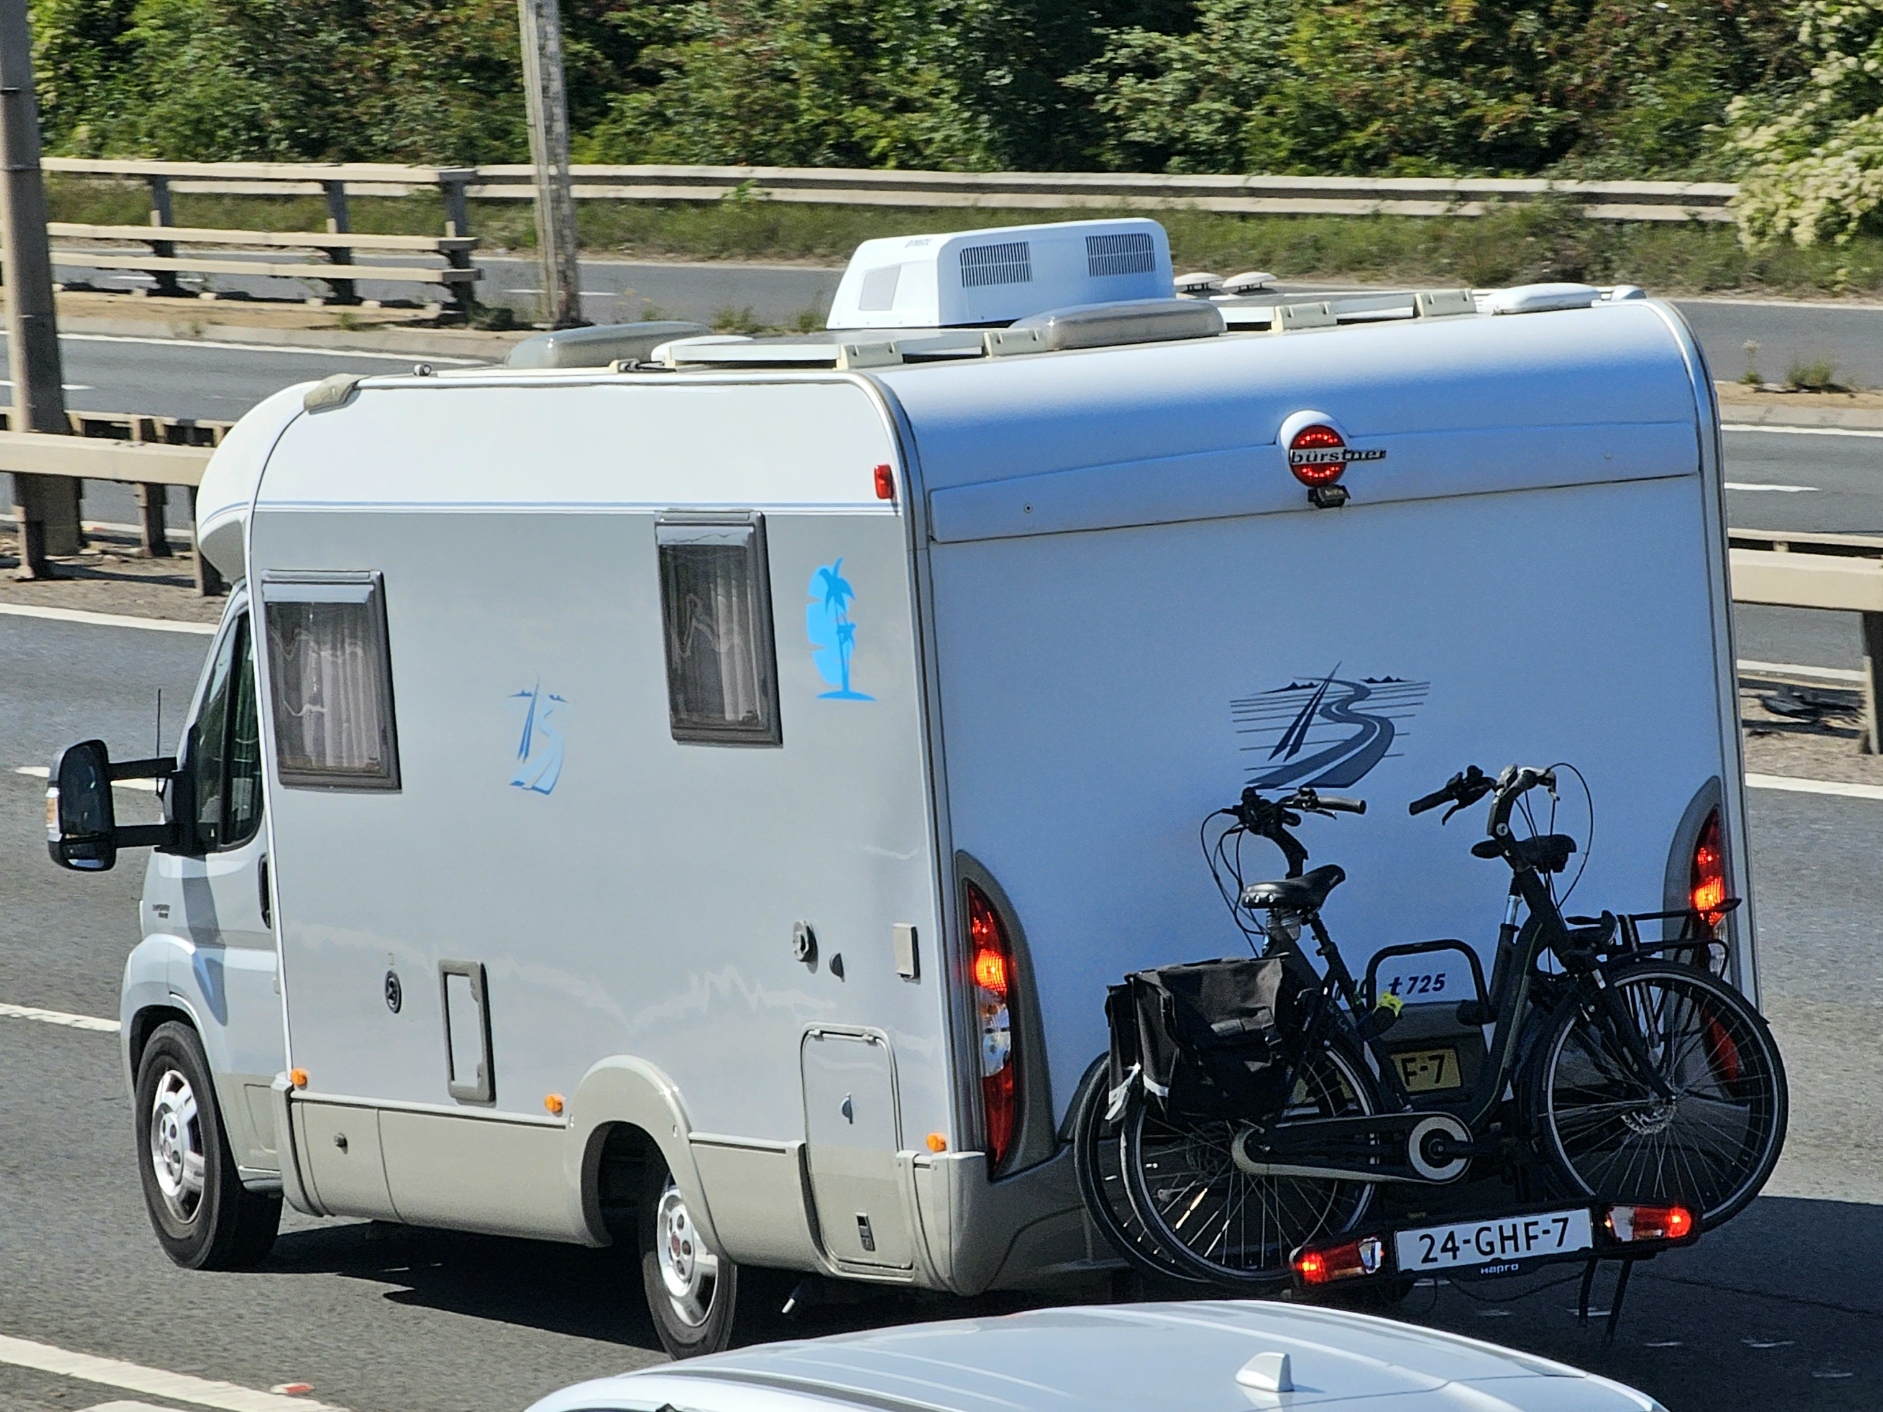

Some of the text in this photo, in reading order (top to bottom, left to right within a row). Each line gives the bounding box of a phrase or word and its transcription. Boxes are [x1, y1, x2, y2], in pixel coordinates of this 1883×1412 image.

[1291, 449, 1387, 464] bürstner
[1388, 973, 1446, 996] t 725
[1418, 1217, 1569, 1264] 24-GHF-7
